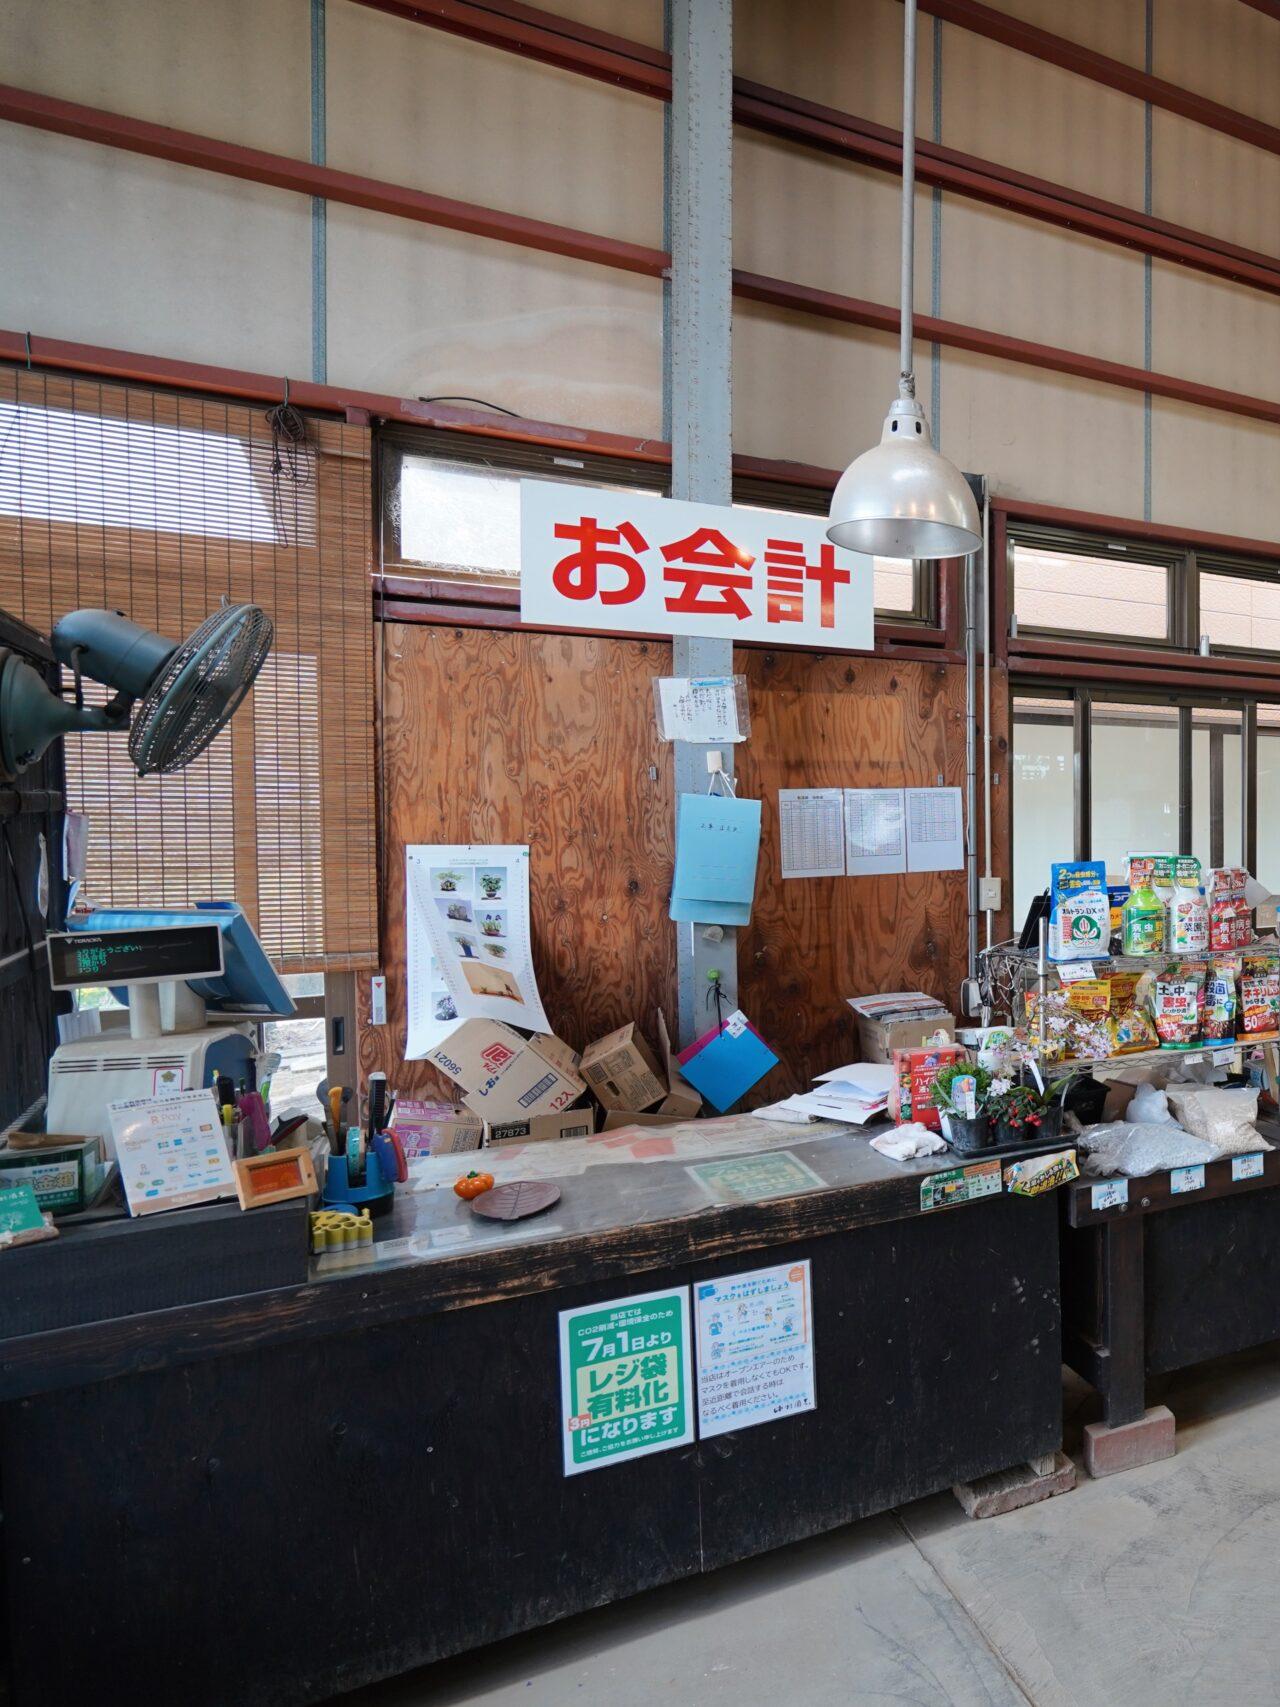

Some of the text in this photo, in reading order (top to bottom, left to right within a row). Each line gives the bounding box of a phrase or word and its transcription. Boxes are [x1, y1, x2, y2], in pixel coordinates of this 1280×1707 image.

[551, 516, 851, 629] お会計
[435, 1050, 462, 1076] 56021
[549, 1090, 575, 1112] 12入
[495, 1127, 527, 1138] 27873
[610, 1308, 642, 1321] 当店では
[582, 1331, 672, 1361] 7月1日より
[590, 1353, 667, 1392] レジ袋
[702, 1355, 795, 1384] 当店はオープンエアーのため
[587, 1380, 669, 1420] 有料化
[569, 1417, 591, 1431] 3円
[581, 1407, 677, 1447] になります
